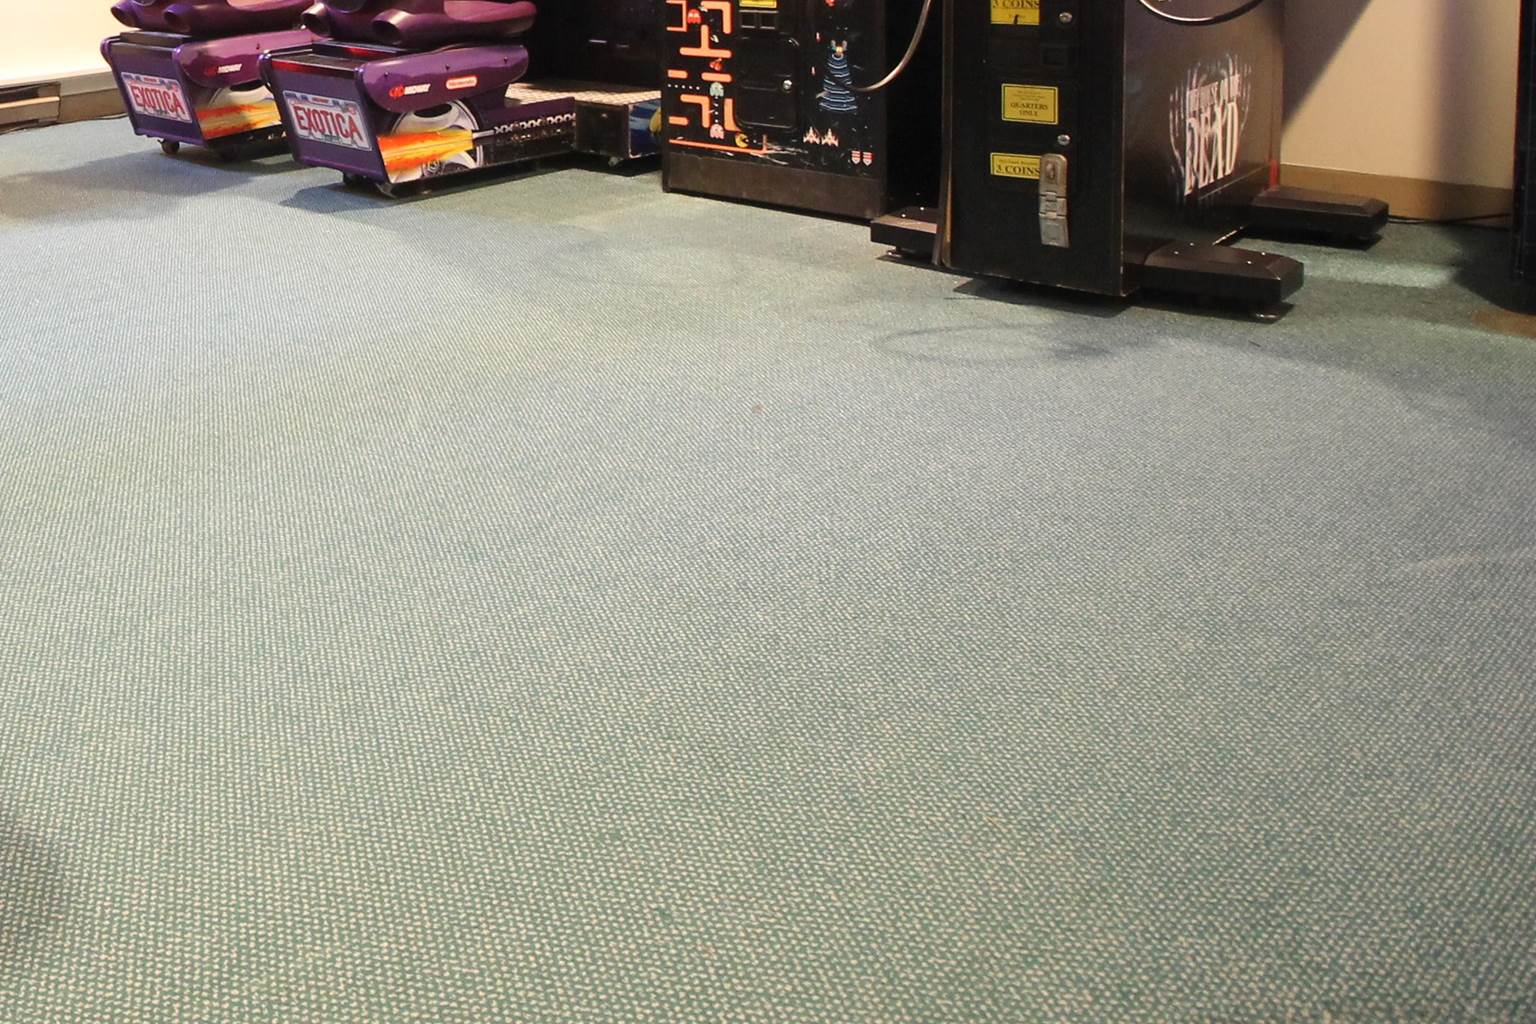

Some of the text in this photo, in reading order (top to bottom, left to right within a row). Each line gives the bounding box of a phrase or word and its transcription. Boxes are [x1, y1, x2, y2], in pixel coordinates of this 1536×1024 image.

[992, 0, 1040, 9] 3 COINS
[130, 84, 186, 116] EXOTICA
[292, 105, 364, 141] EXOTICA
[1005, 164, 1040, 176] COINS
